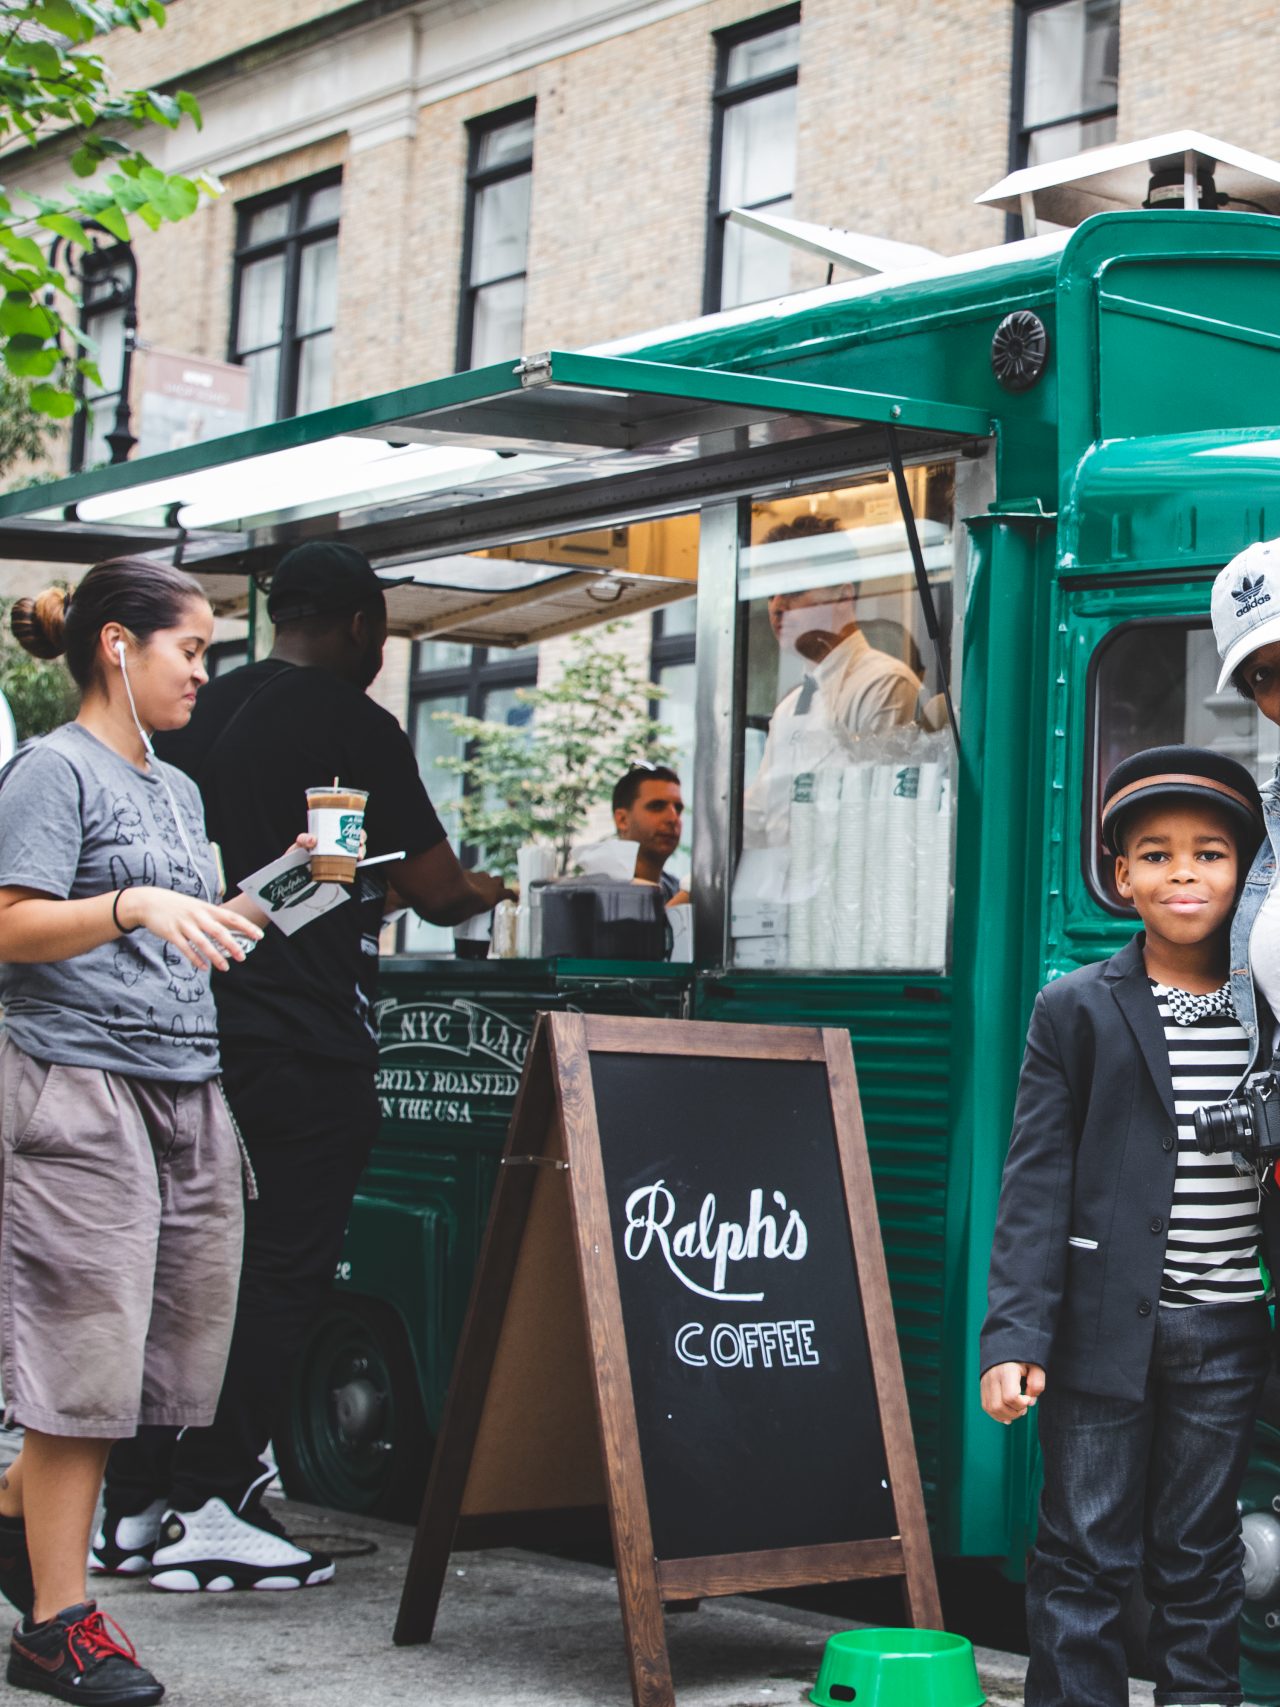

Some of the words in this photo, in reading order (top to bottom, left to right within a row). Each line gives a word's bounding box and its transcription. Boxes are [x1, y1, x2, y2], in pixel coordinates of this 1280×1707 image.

[1236, 594, 1271, 617] adidas
[401, 1011, 451, 1043] NYC
[480, 1015, 531, 1065] LAU
[432, 1071, 520, 1096] ROASTED
[398, 1099, 433, 1121] THE
[435, 1101, 472, 1123] USA
[624, 1179, 808, 1301] Ralph's
[675, 1320, 820, 1368] COFFEE
